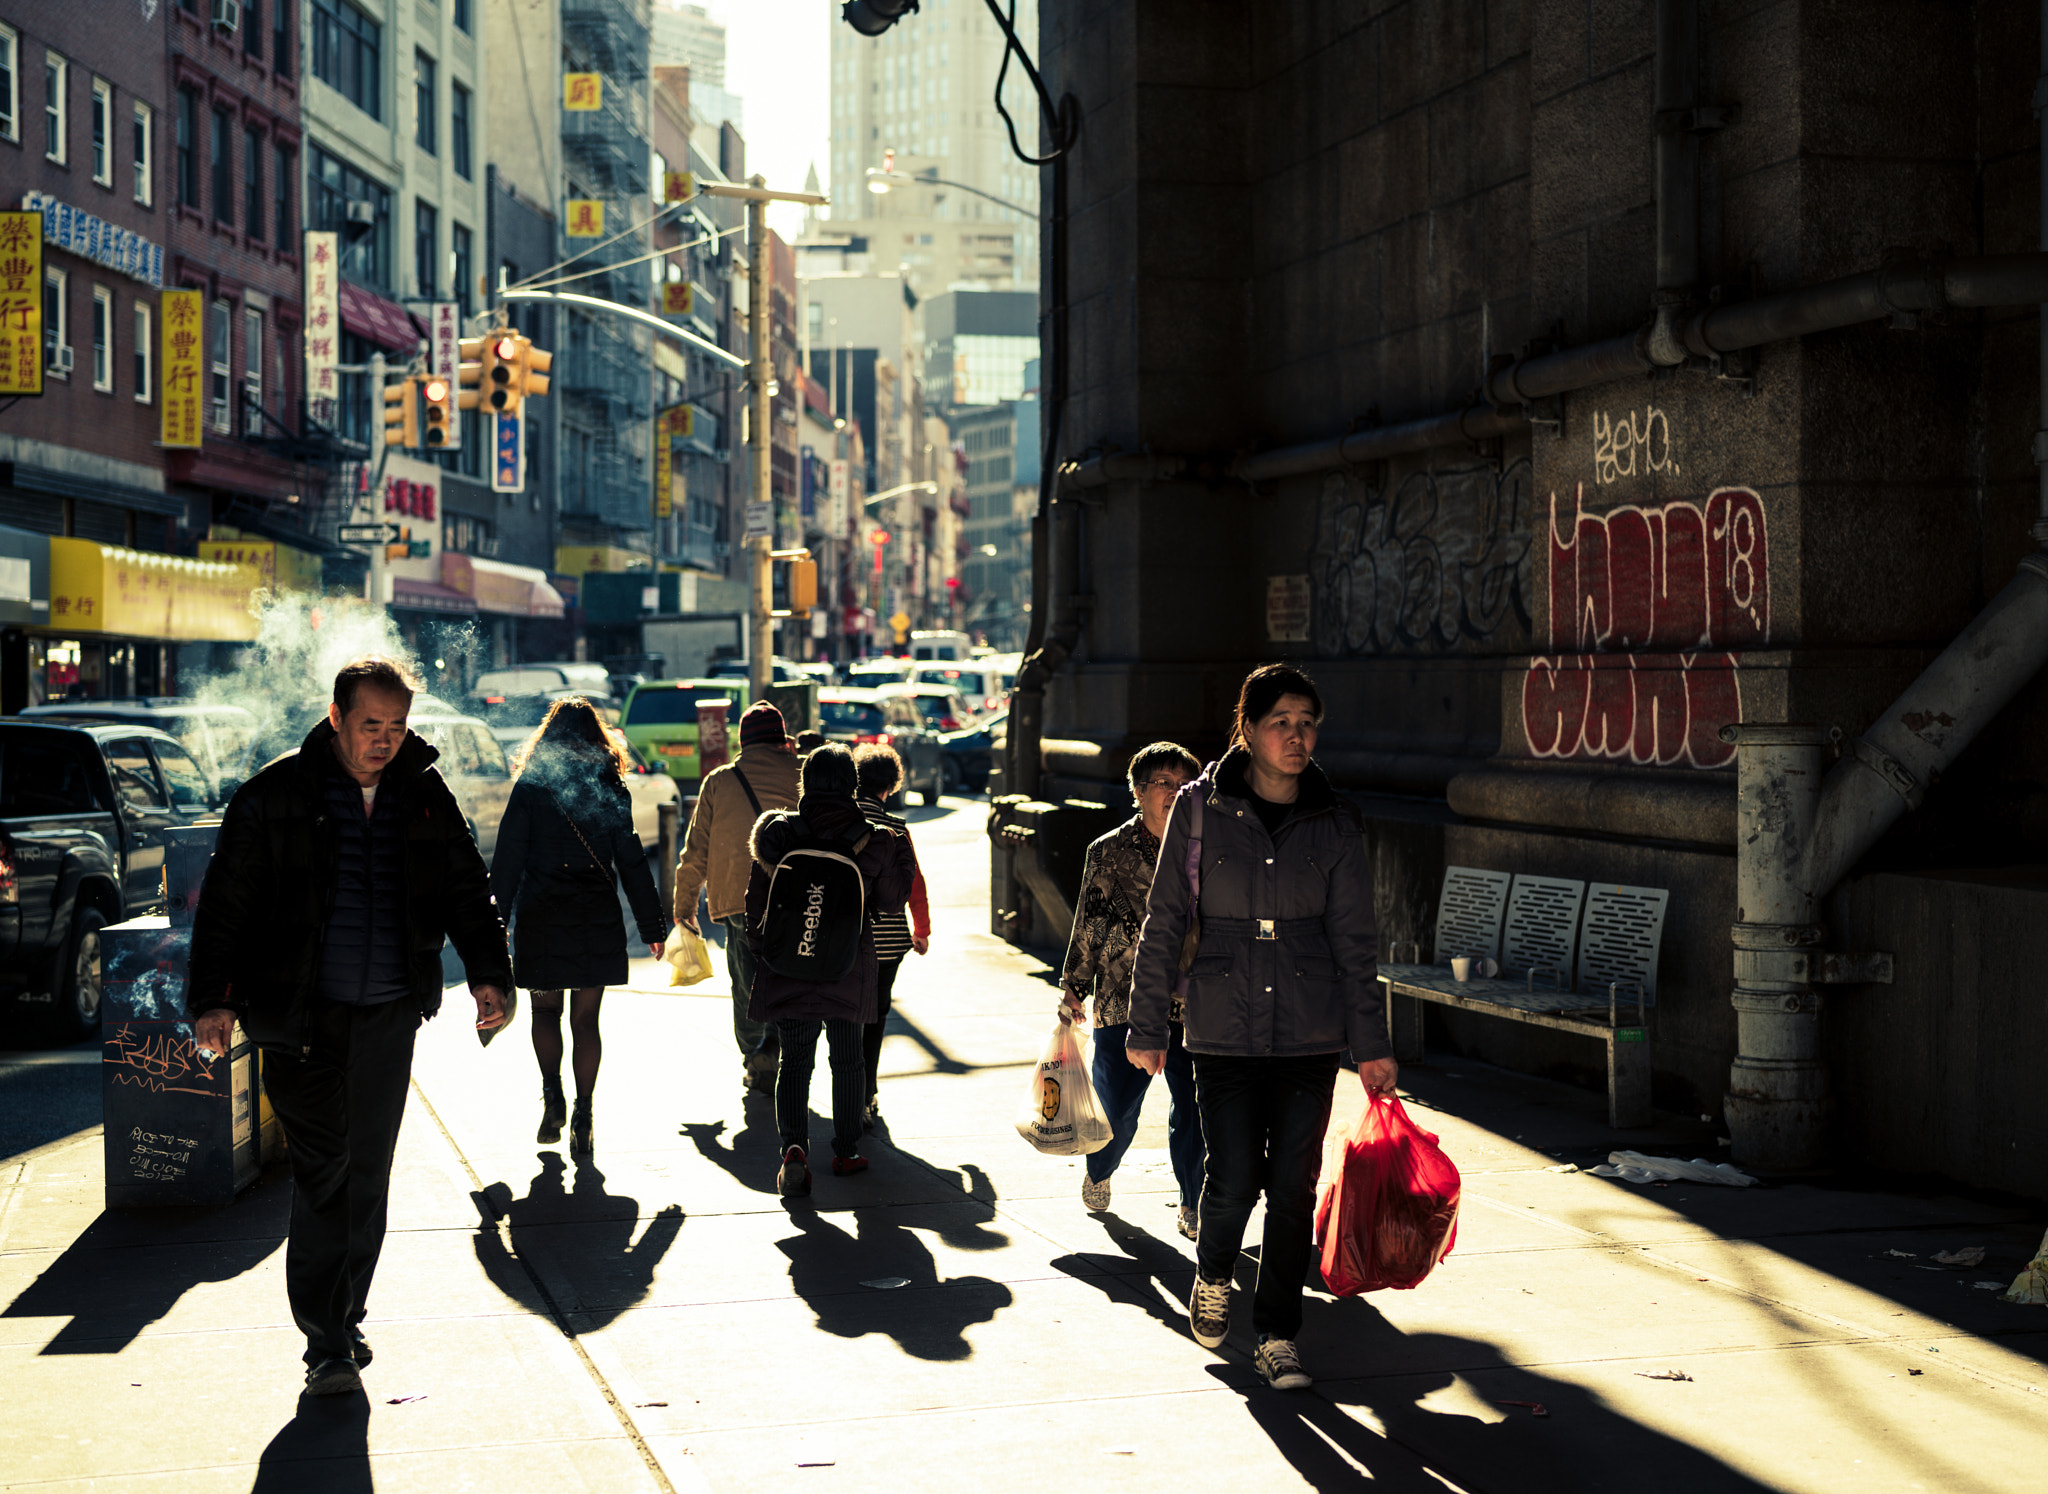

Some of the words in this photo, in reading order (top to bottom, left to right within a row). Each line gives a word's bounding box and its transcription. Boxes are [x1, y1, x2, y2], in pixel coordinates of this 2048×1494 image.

[797, 882, 825, 957] Reebok
[128, 1126, 159, 1144] RACE
[159, 1134, 175, 1145] TO
